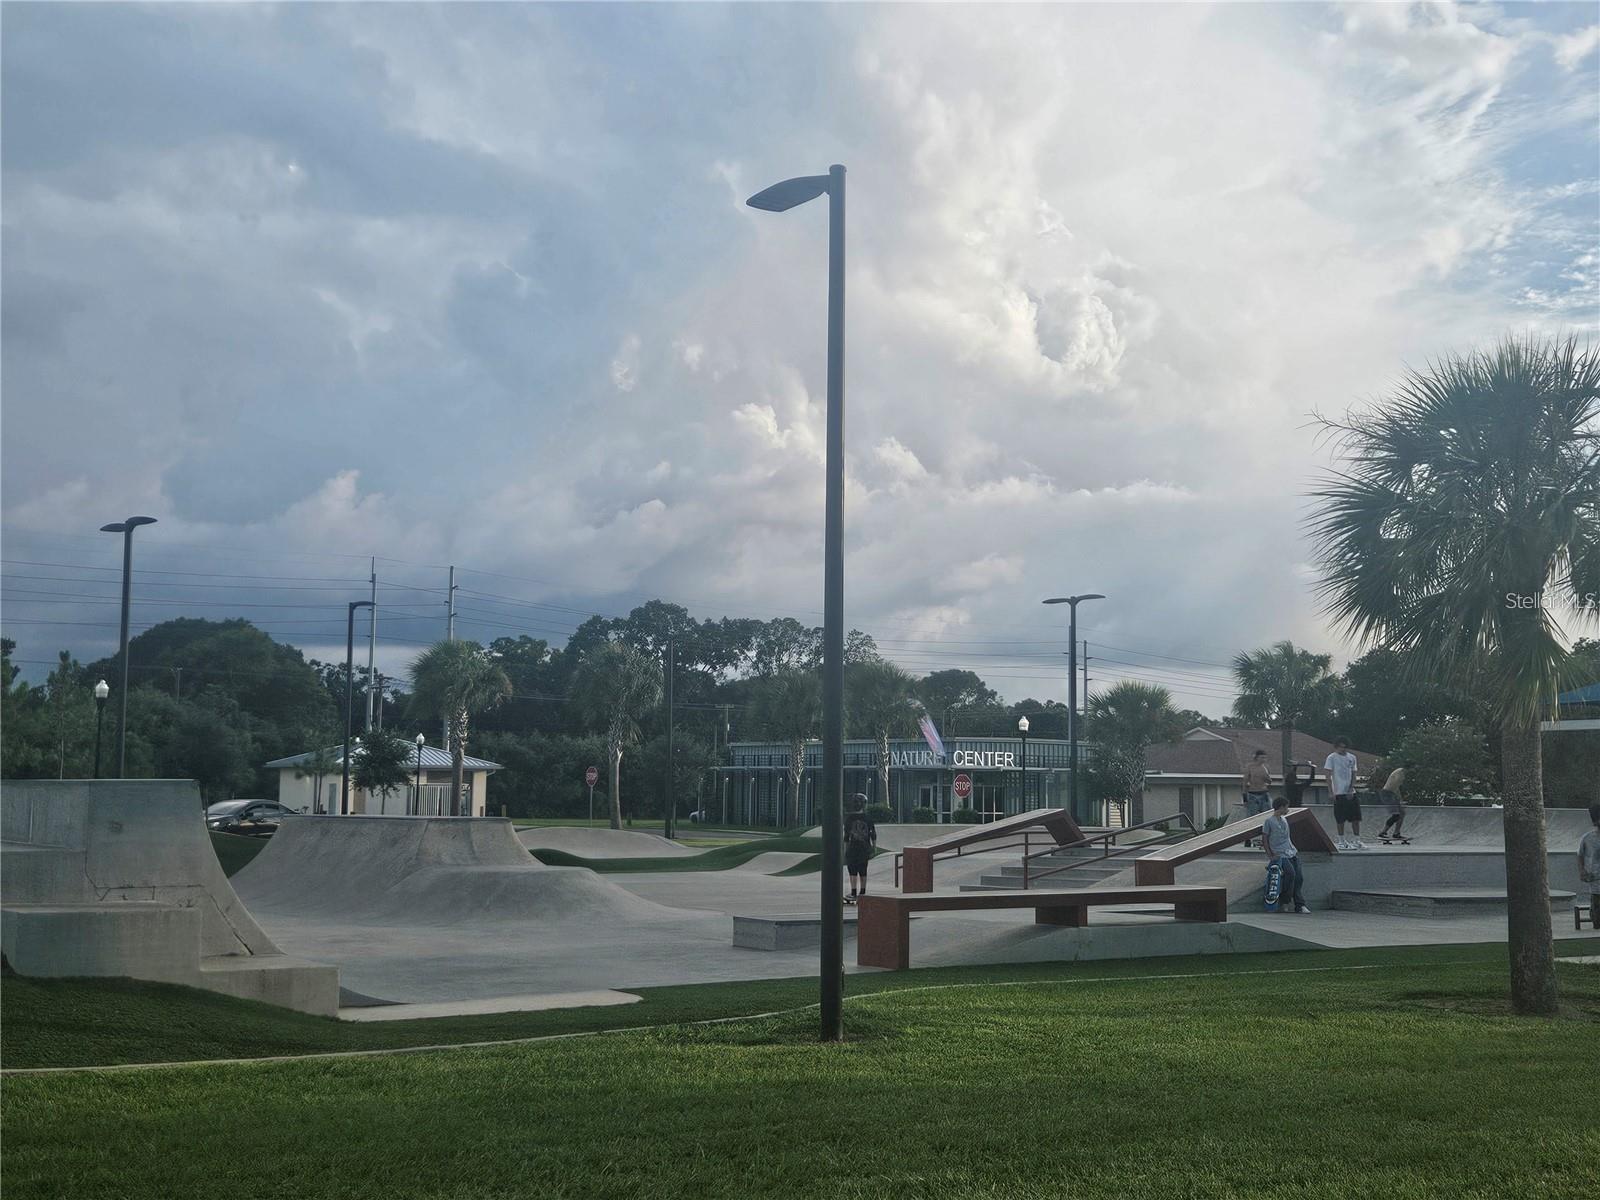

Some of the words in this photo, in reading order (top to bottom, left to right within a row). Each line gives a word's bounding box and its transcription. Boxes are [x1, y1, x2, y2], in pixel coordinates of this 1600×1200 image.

[890, 750, 943, 766] NATURE
[953, 750, 1015, 767] CENTER
[955, 781, 971, 791] STOP
[1269, 873, 1279, 897] REAL
